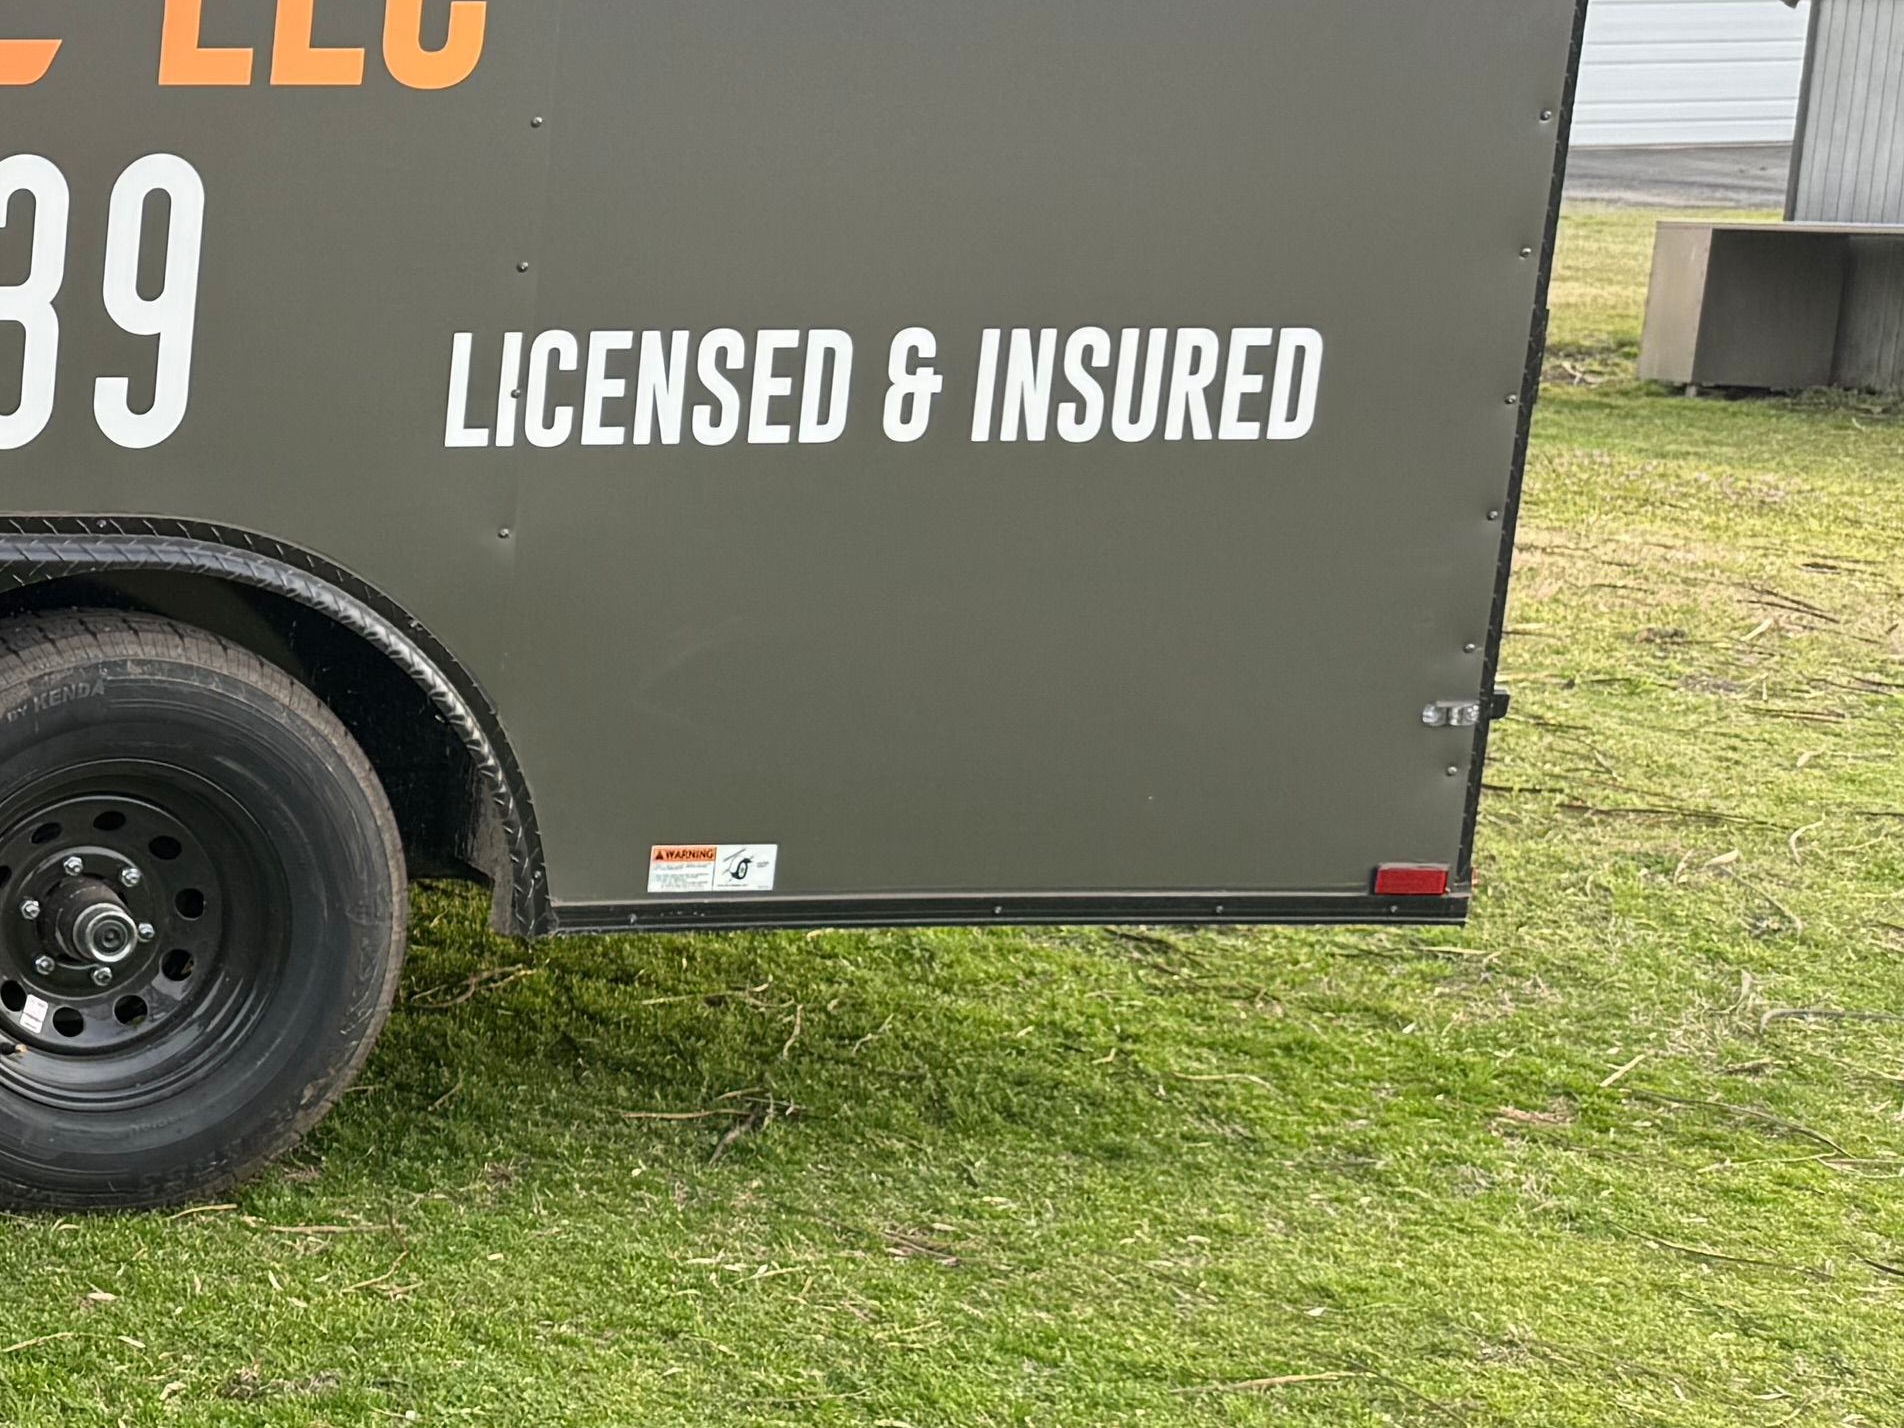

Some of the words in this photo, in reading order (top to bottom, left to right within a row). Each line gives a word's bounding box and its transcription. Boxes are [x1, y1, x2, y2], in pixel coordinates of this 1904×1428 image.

[444, 328, 854, 448] LICENSED
[882, 327, 944, 442] &
[971, 326, 1324, 443] INSURED
[32, 676, 106, 711] KENDA
[665, 848, 715, 861] WARNING
